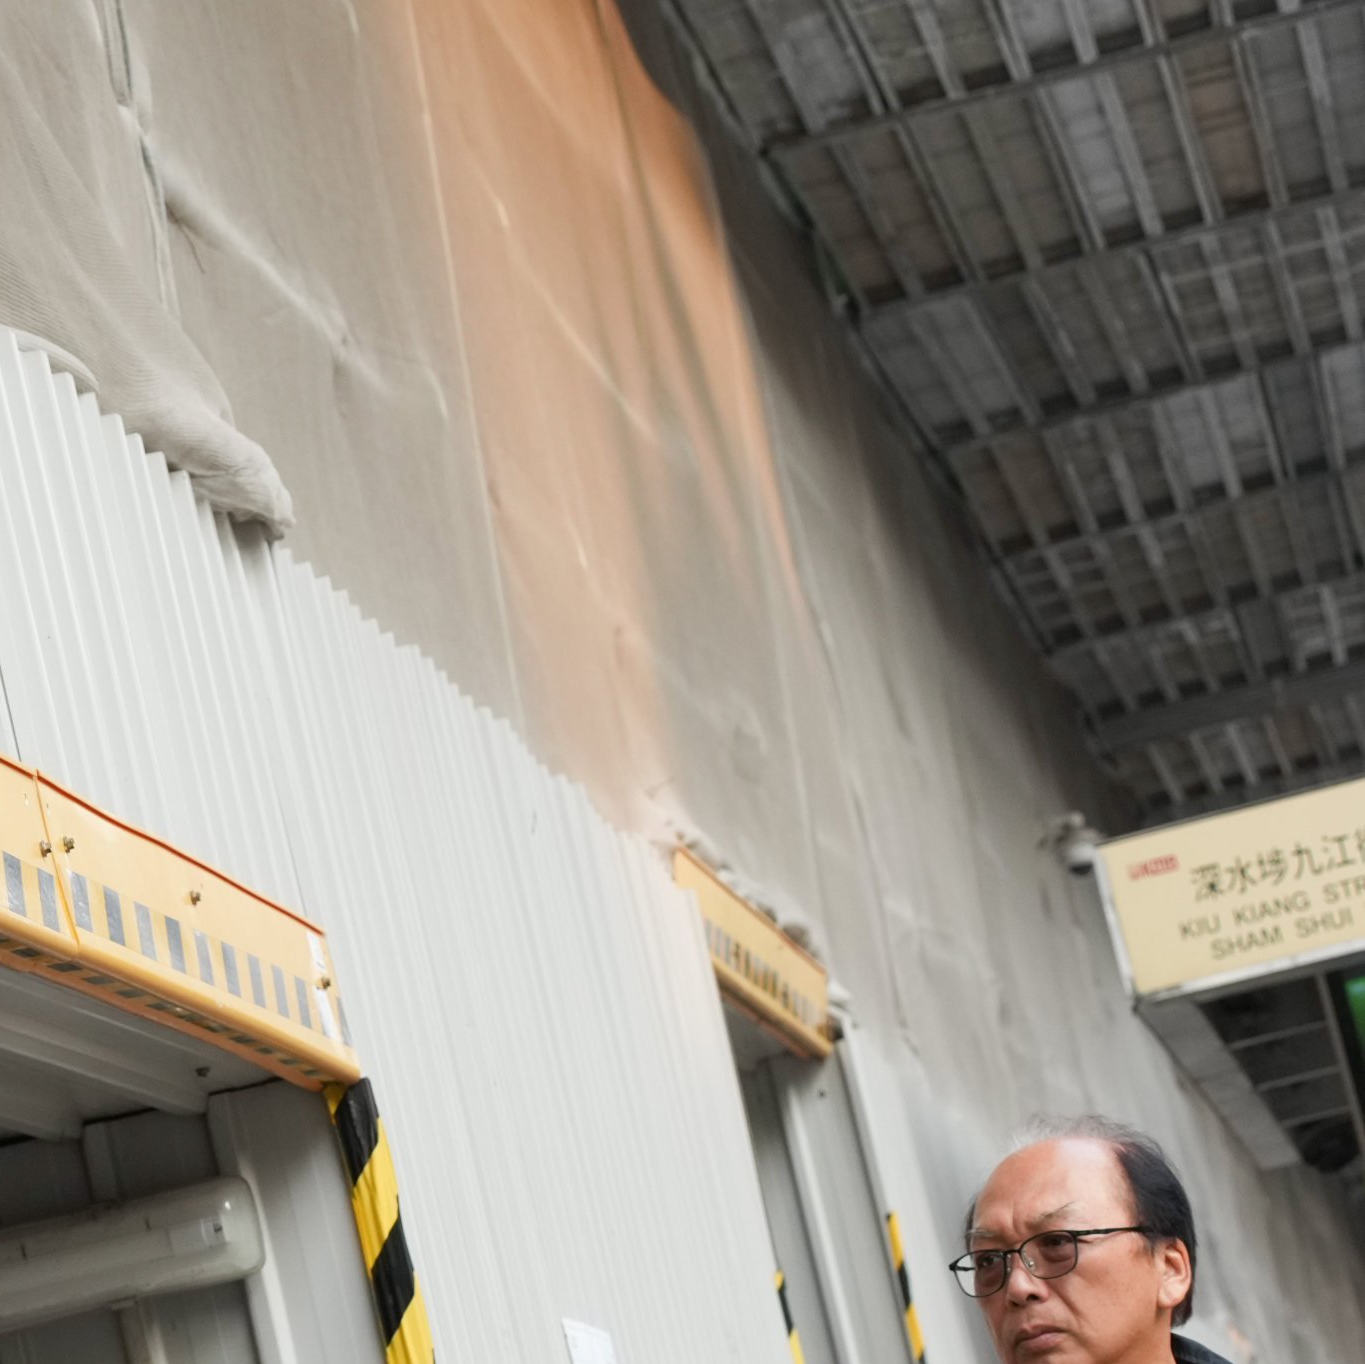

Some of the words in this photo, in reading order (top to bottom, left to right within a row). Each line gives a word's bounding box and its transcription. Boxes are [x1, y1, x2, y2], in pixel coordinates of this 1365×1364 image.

[1179, 914, 1221, 941] KIU
[1233, 890, 1311, 926] KIANG
[1210, 925, 1284, 960] SHAM
[1294, 907, 1354, 939] SHUI
